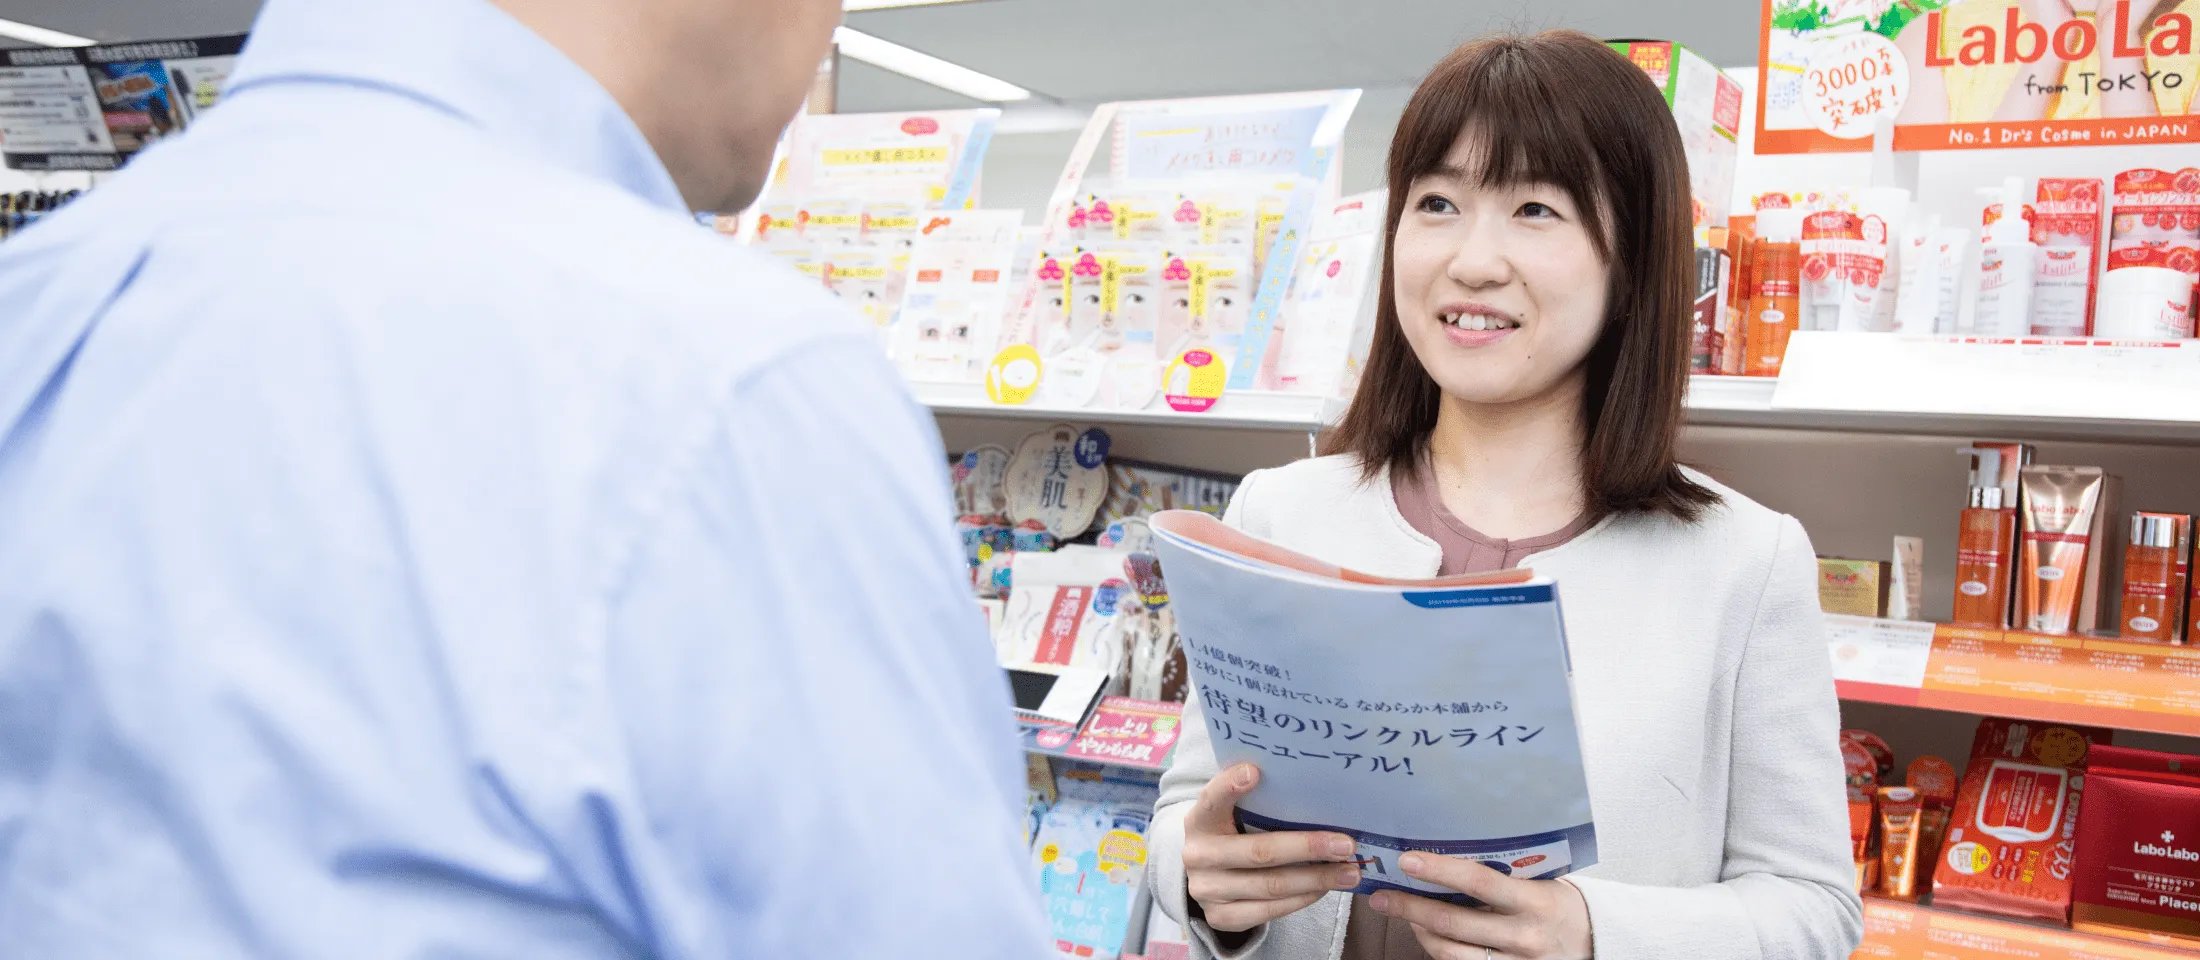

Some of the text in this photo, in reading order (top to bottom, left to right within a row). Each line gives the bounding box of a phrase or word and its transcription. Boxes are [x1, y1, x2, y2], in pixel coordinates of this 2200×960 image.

[1925, 0, 2200, 68] Labo La
[2024, 70, 2183, 96] from TOKYO
[1949, 123, 2188, 145] No.1 Dr's Cosme in JAPAN
[1194, 657, 1509, 715] 2秒に1個売れている なめらか本舗から
[1202, 684, 1545, 748] 待望のリンクルライン
[2133, 840, 2199, 862] Labo Labo
